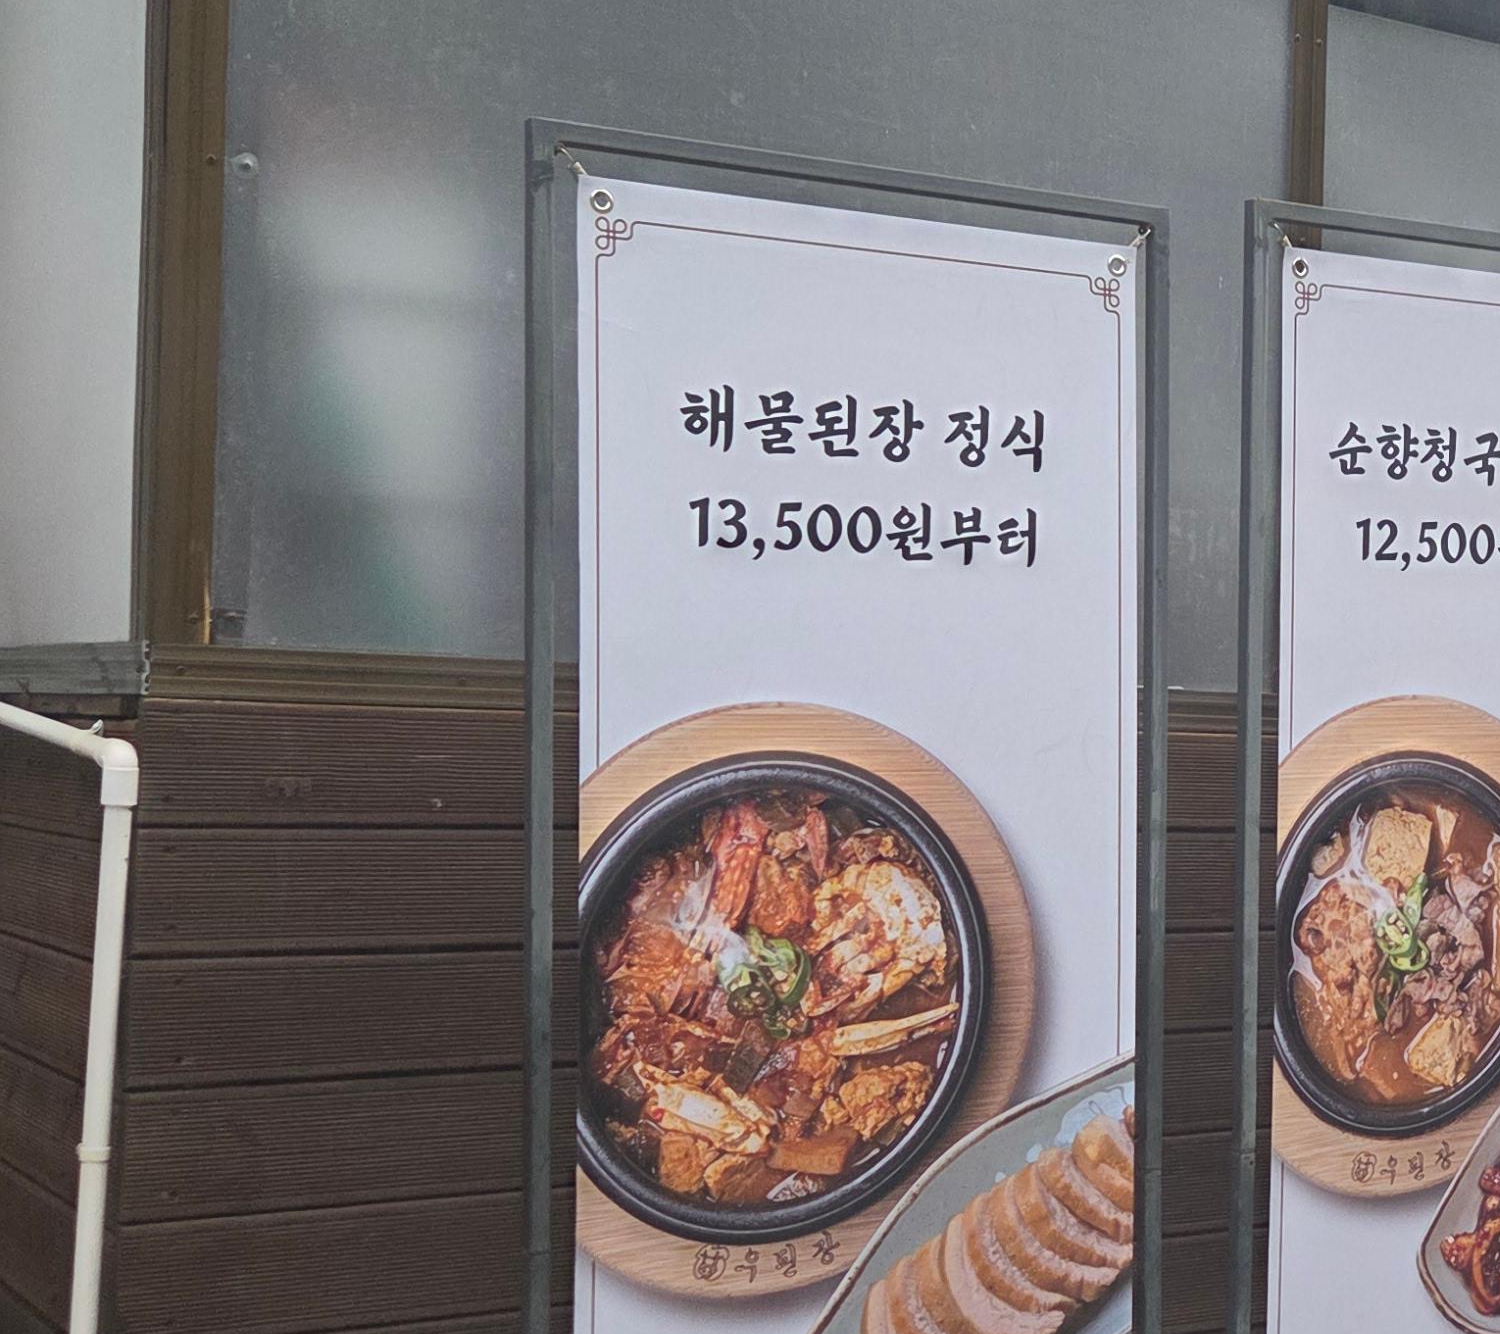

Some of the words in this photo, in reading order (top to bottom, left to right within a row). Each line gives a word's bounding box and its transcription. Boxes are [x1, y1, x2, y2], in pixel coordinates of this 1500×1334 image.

[679, 383, 925, 464] 해물된장
[943, 405, 1045, 473] 정식
[688, 496, 1038, 568] 13,500원부터
